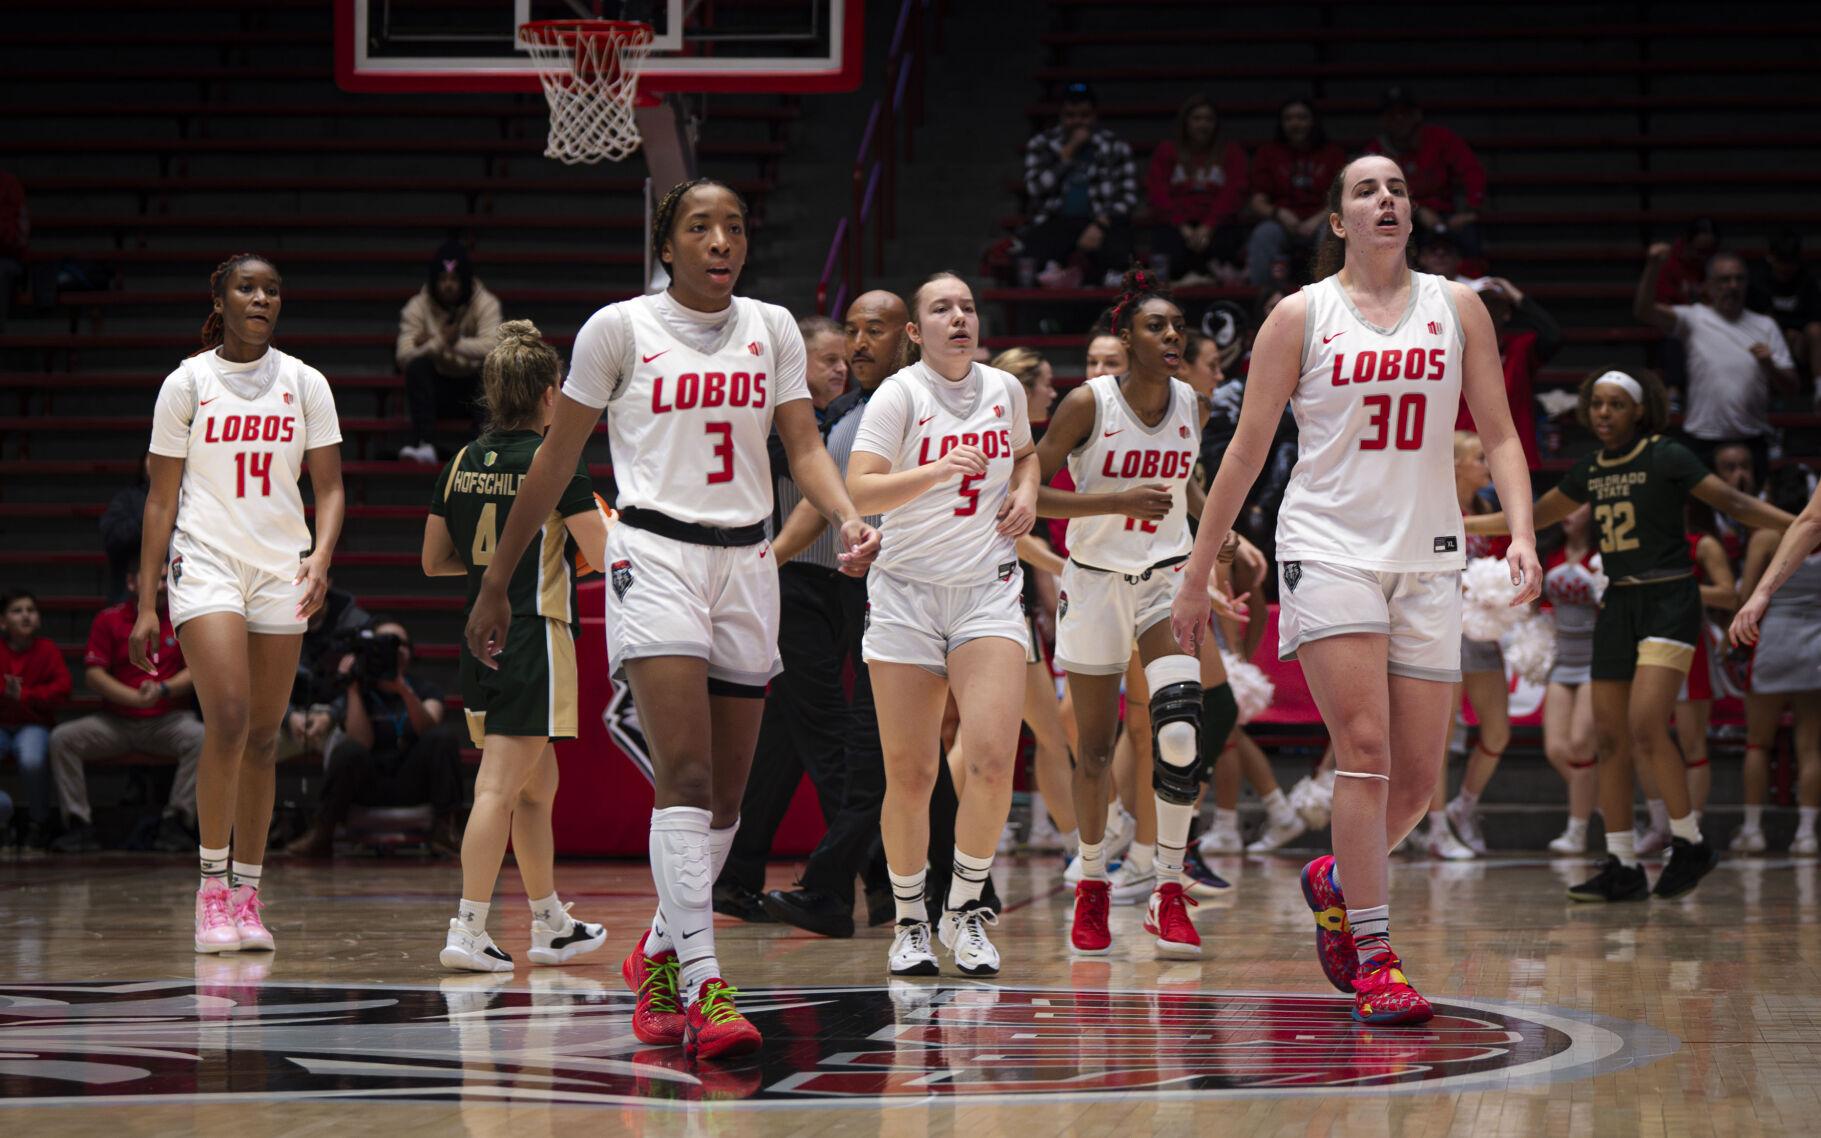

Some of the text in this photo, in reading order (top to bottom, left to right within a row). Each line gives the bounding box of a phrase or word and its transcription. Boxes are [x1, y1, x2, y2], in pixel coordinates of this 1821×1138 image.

[1331, 347, 1446, 387] LOBOS
[651, 371, 767, 415] LOBOS
[204, 415, 296, 443] LOBOS
[1359, 392, 1427, 451] 30
[235, 451, 274, 498] 14
[704, 421, 734, 485] 3
[1101, 449, 1192, 479] LOBOS
[953, 471, 986, 517] 5
[1586, 471, 1647, 492] COLORADO
[1597, 484, 1630, 500] STATE
[471, 502, 498, 566] 4
[1595, 501, 1640, 554] 32
